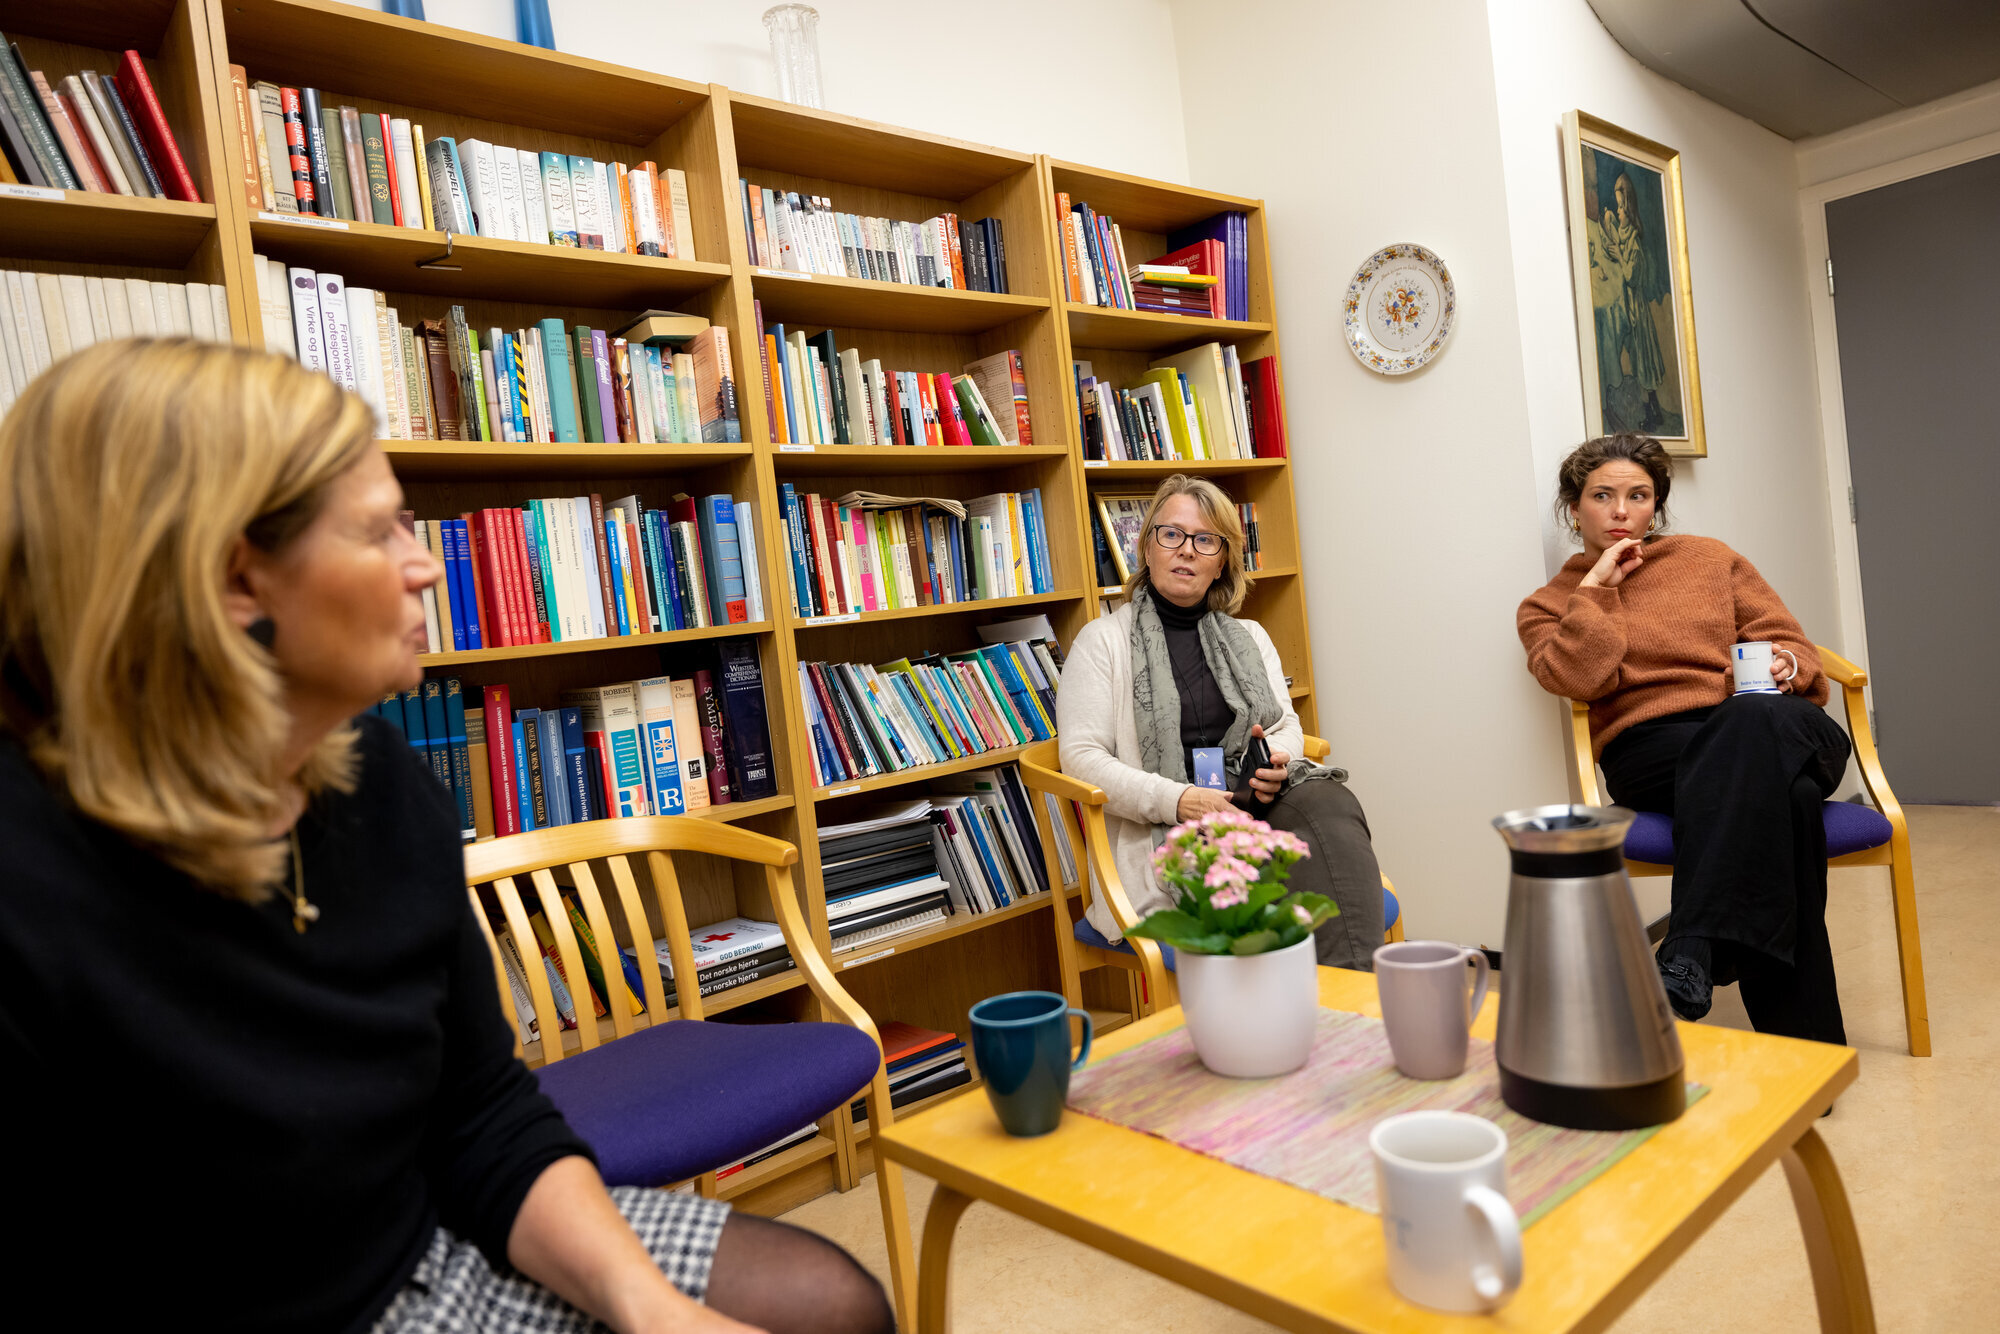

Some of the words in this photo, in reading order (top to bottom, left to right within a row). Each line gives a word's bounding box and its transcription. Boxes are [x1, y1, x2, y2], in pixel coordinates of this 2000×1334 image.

[288, 93, 299, 113] NICK
[292, 116, 306, 150] HORNBY
[298, 155, 310, 181] FRITT
[311, 126, 326, 184] STEINFELD
[476, 155, 491, 198] RILEY
[498, 160, 515, 204] RILEY
[522, 162, 537, 206] RILEY
[546, 163, 565, 214] RILEY
[302, 182, 313, 202] FALL
[559, 170, 572, 211] LUCINDA
[572, 169, 590, 219] RILEY
[585, 175, 598, 215] LUCINDA
[1064, 211, 1073, 226] Alt
[940, 238, 949, 266] FRANCIS
[304, 305, 317, 334] Virke
[306, 336, 318, 352] og
[338, 322, 354, 381] Framvekst
[401, 328, 414, 368] SKOLENS
[406, 371, 420, 416] SANGBOK
[803, 533, 812, 550] Nærhet
[603, 687, 632, 696] ROBERT
[729, 674, 758, 683] DICTIONARY
[526, 722, 536, 749] ENGELSK
[703, 686, 726, 773] SYMBOL-LEX
[439, 749, 450, 776] STORE
[451, 747, 464, 787] LEKSIKON
[459, 746, 470, 772] STORE
[529, 750, 538, 771] NORSK
[573, 754, 583, 776] Norsk
[502, 782, 512, 811] MEDISINSKE
[532, 775, 541, 794] NORSK
[535, 795, 545, 822] ENGELSK
[576, 776, 589, 821] rettskrivning
[659, 788, 683, 809] R
[718, 950, 733, 961] GOD
[732, 941, 764, 957] BEDRING!
[698, 970, 713, 982] Det
[712, 965, 738, 978] norske
[737, 957, 759, 971] hjerte
[698, 984, 713, 995] Det
[711, 977, 738, 991] norske
[737, 970, 759, 983] hjerte
[556, 988, 569, 1005] tenke
